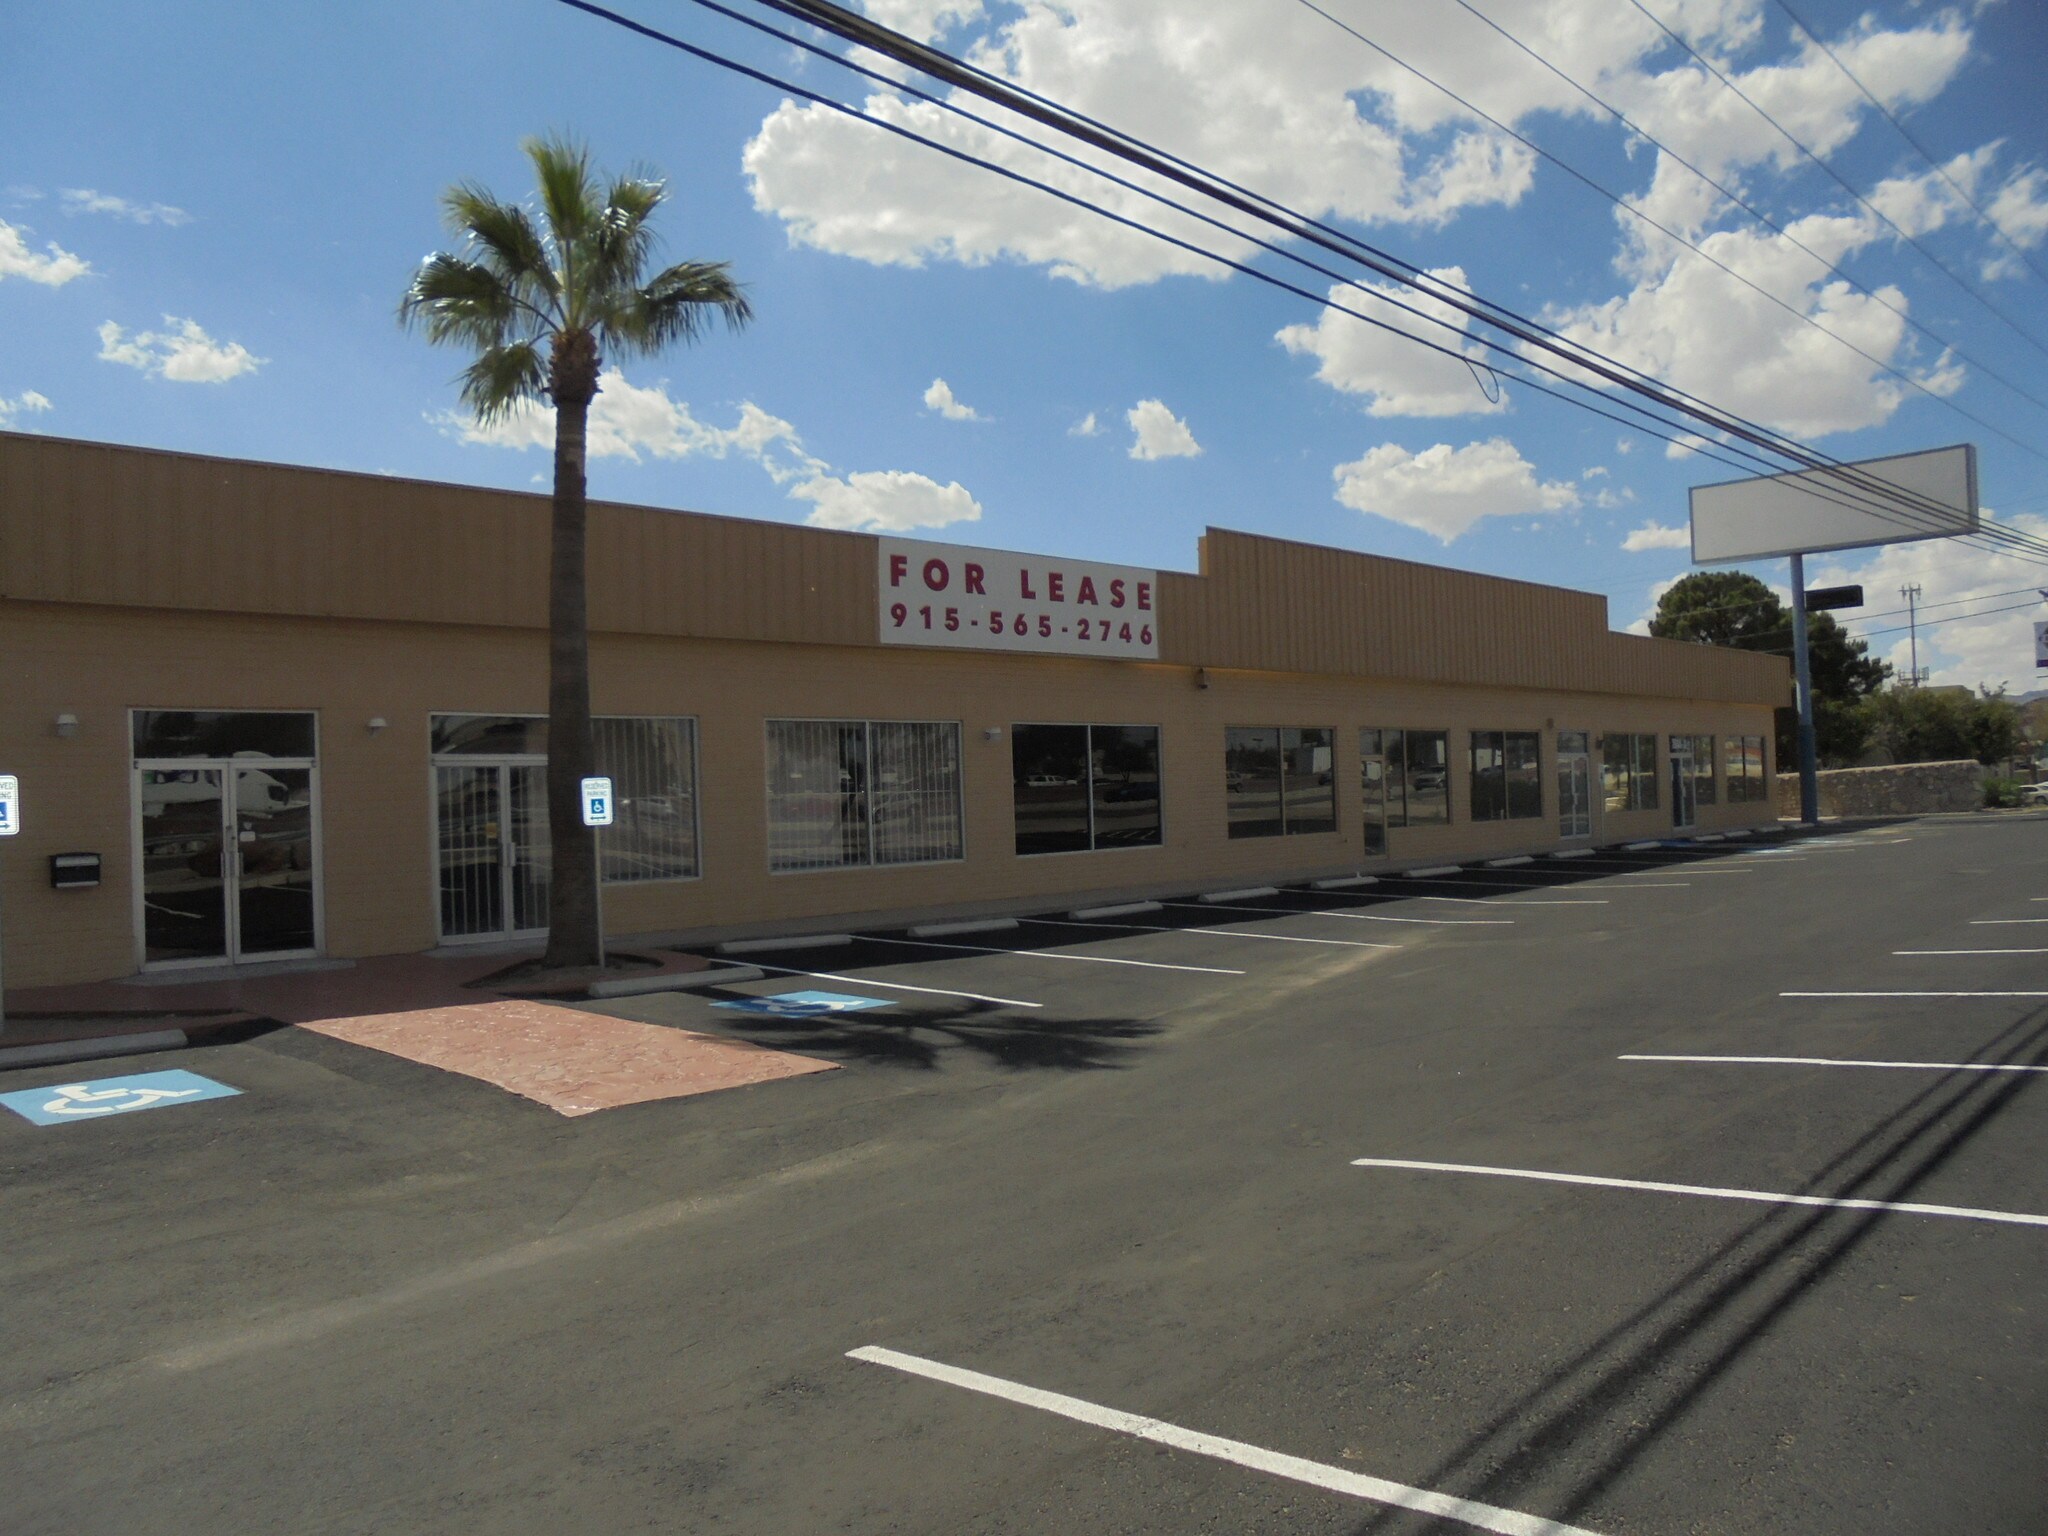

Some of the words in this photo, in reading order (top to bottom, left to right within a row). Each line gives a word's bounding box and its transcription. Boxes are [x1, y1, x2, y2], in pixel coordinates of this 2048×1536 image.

[890, 554, 986, 595] FOR
[1020, 569, 1152, 611] LEASE
[890, 602, 1153, 646] 915-565-2746
